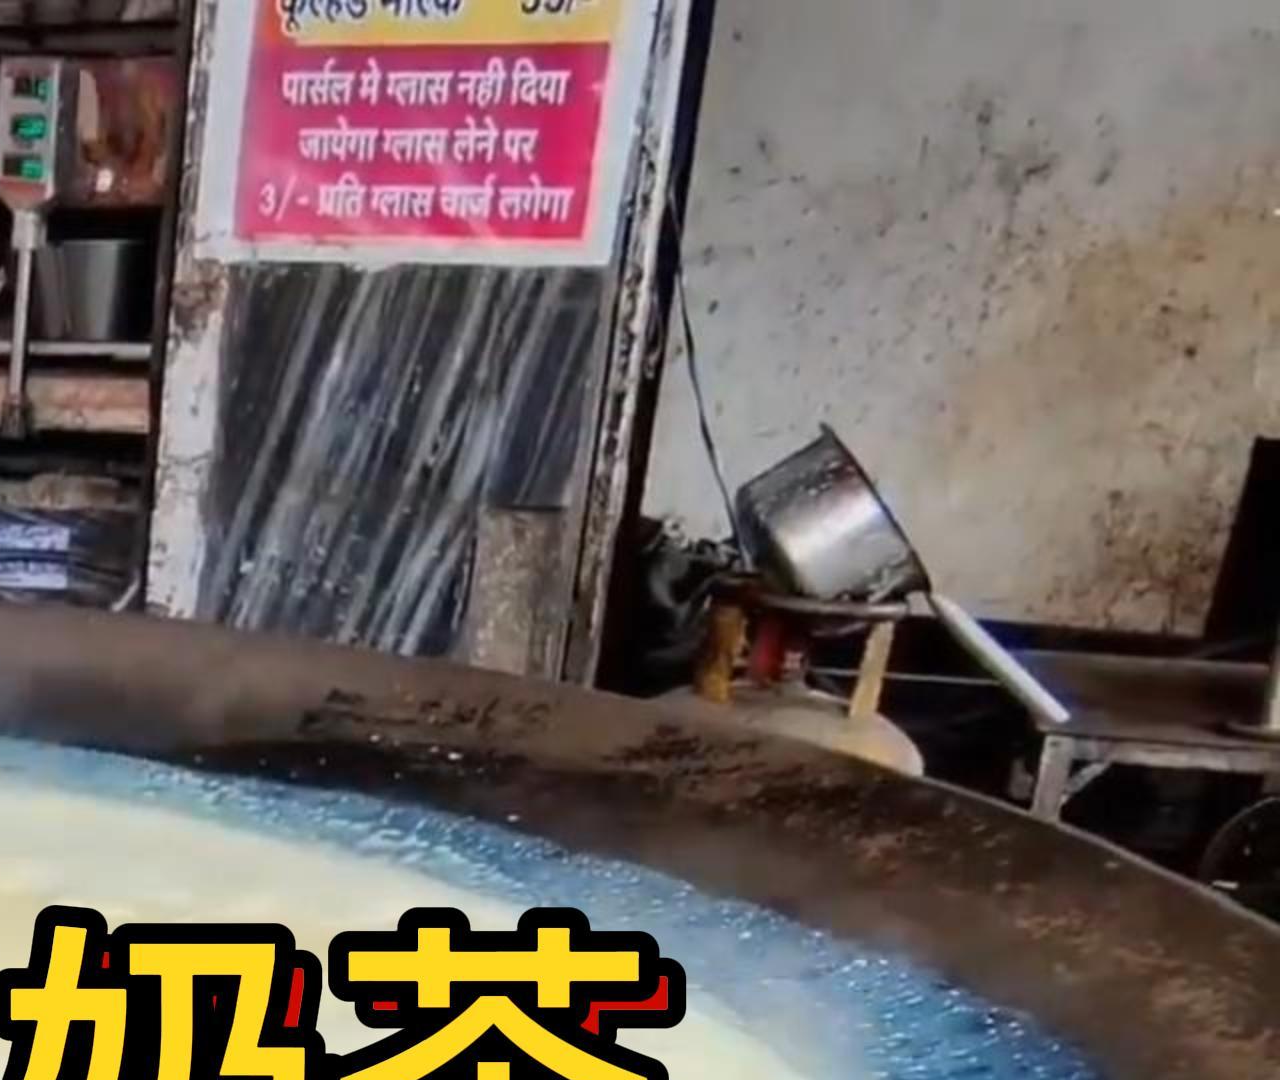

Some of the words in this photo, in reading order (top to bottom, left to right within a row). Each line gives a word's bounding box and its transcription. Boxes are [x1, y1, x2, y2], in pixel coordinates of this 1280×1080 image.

[282, 58, 354, 106] पार्सल
[387, 70, 454, 106] ग्लास
[511, 57, 572, 106] दिया
[384, 128, 449, 164] ग्लास
[453, 115, 499, 162] लेने
[503, 128, 539, 162] पर
[372, 184, 436, 218] ग्लास
[499, 172, 575, 221] लगेगा
